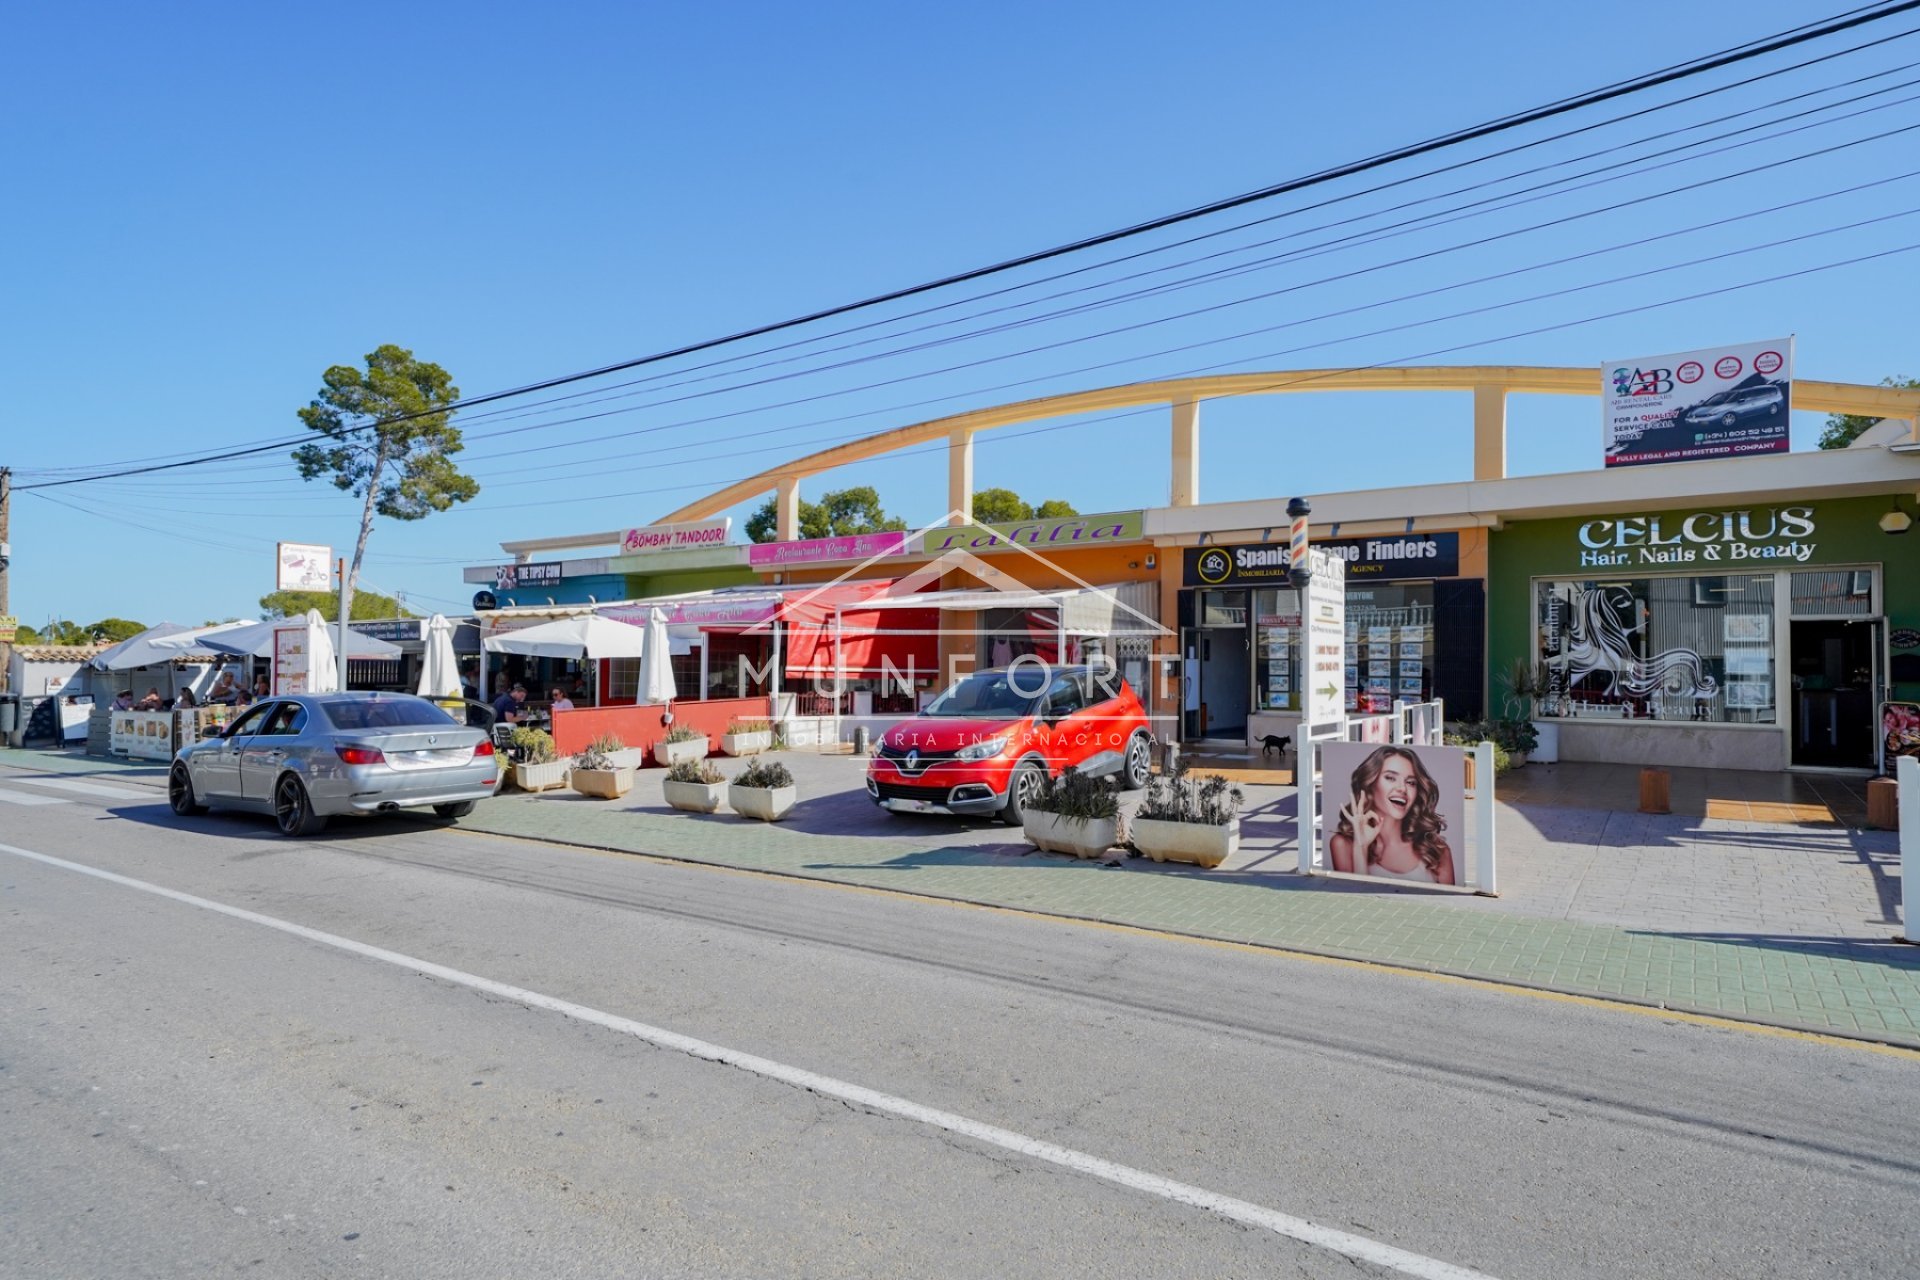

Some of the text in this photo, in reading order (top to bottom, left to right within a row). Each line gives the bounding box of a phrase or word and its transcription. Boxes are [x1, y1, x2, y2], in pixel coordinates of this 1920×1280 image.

[1614, 416, 1631, 424] FOR
[1641, 410, 1680, 421] QUALITY
[1614, 420, 1675, 432] SERVICE CALL
[1615, 431, 1643, 441] TODAY
[1616, 441, 1776, 462] FULLY LEGAL AND REGISTERED COMPANY
[1578, 506, 1816, 549] CELCIUS
[632, 528, 725, 548] BOMBAY TANDOORI
[1236, 546, 1291, 567] Spanis
[1366, 539, 1437, 561] Finders
[1639, 547, 1695, 564] Nails
[1703, 544, 1722, 561] &
[1730, 540, 1817, 562] Beauty
[518, 564, 560, 580] THE TIPSY COW
